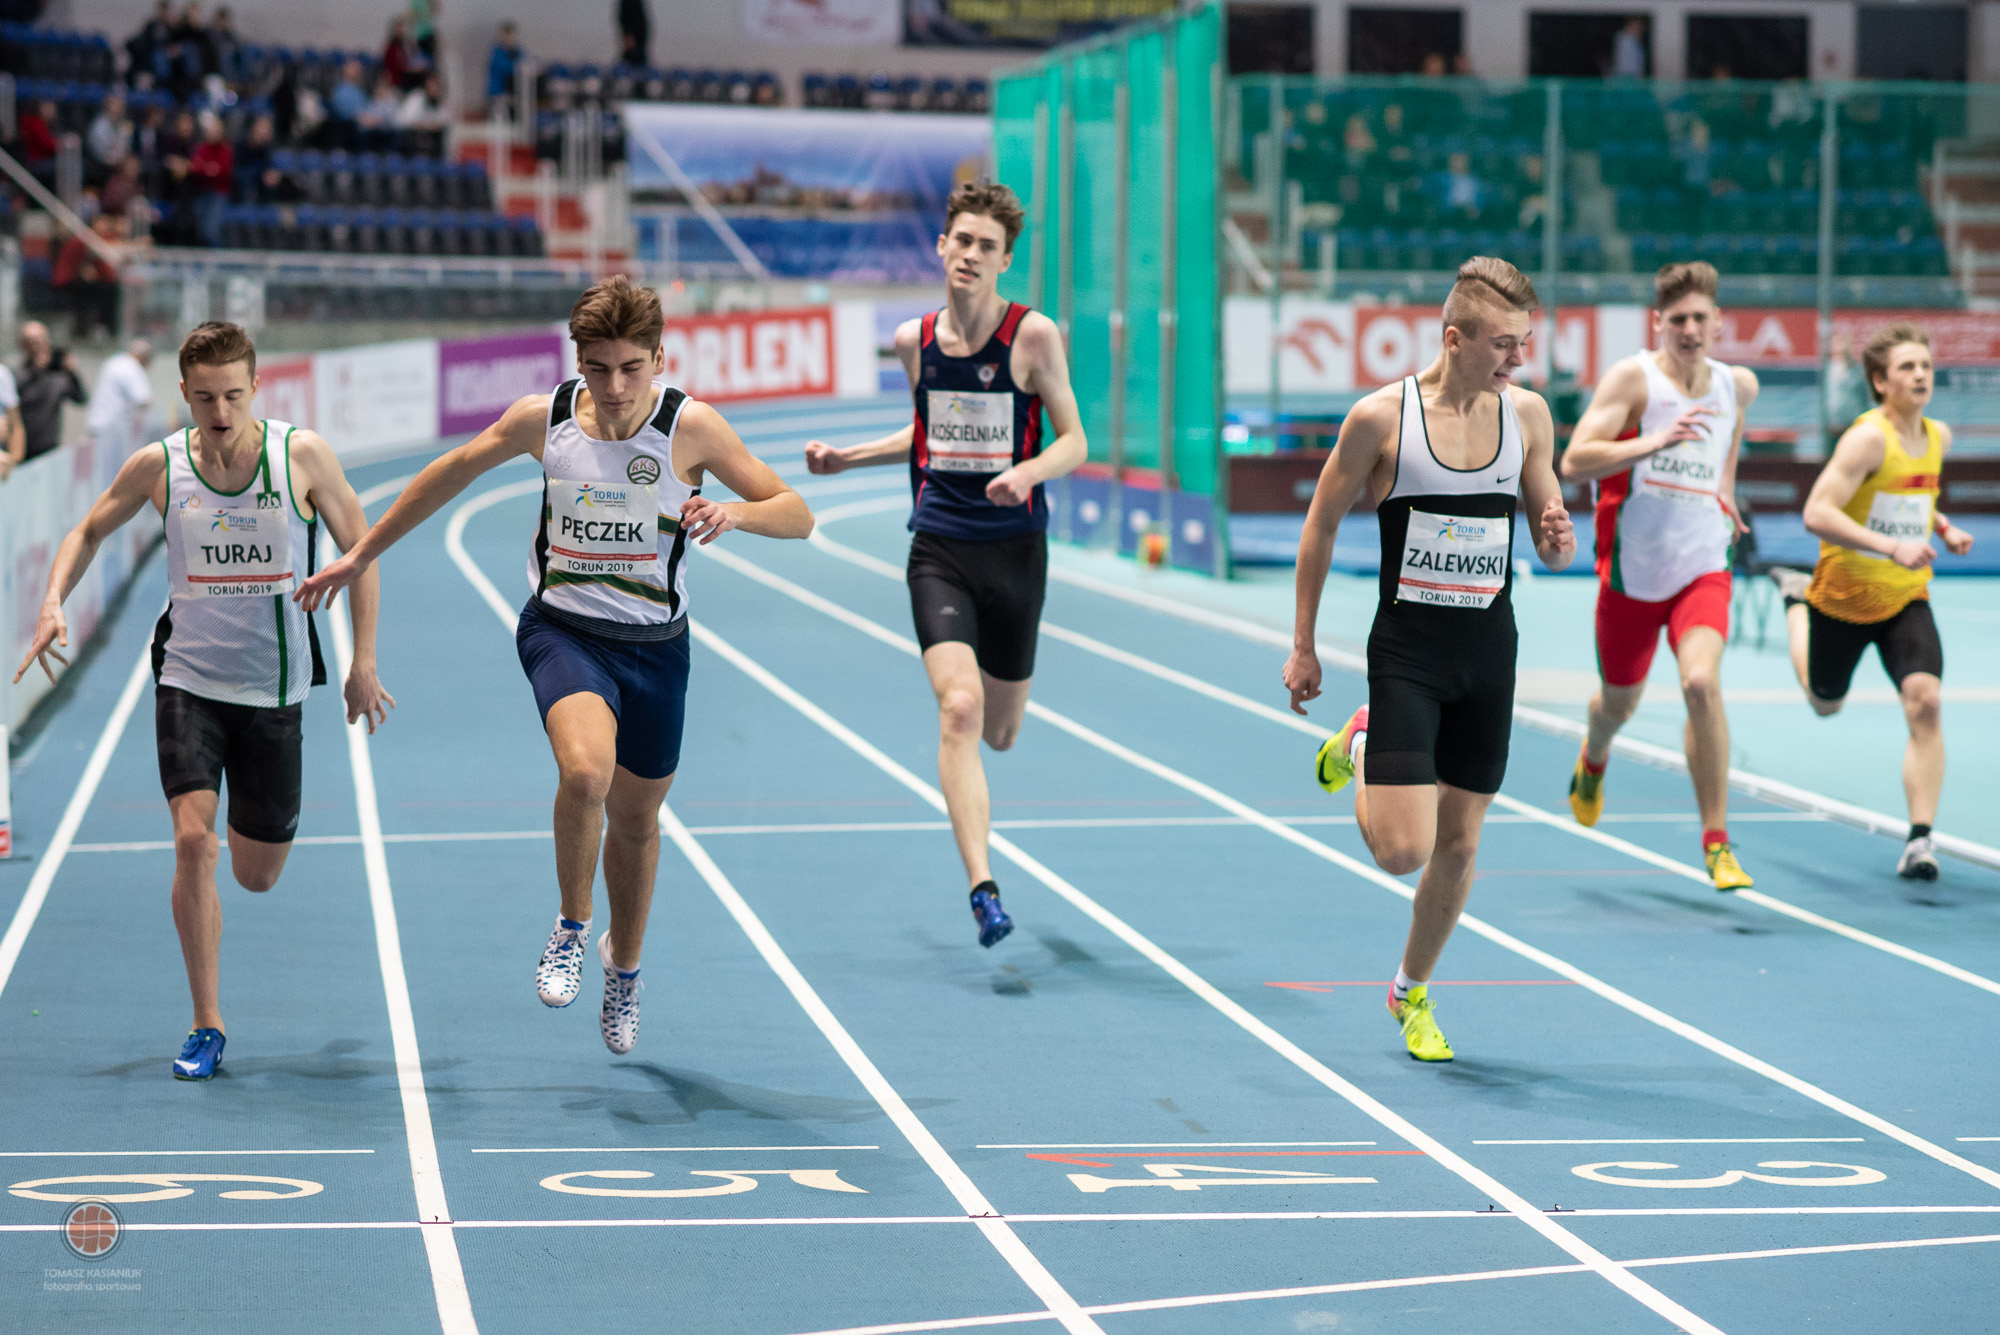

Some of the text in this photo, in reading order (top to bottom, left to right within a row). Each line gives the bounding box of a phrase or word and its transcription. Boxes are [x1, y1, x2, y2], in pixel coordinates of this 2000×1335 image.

[661, 319, 827, 396] ORLEN
[931, 420, 1009, 442] KOŚCIELNIAK
[632, 459, 656, 472] RKS
[562, 515, 644, 544] PĘCZEK
[201, 544, 272, 564] TURAJ
[1406, 547, 1504, 576] ZALEWSKI
[568, 560, 634, 572] TORUŃ 2019
[208, 582, 272, 595] TORUŃ 2019
[1459, 594, 1484, 606] 2019
